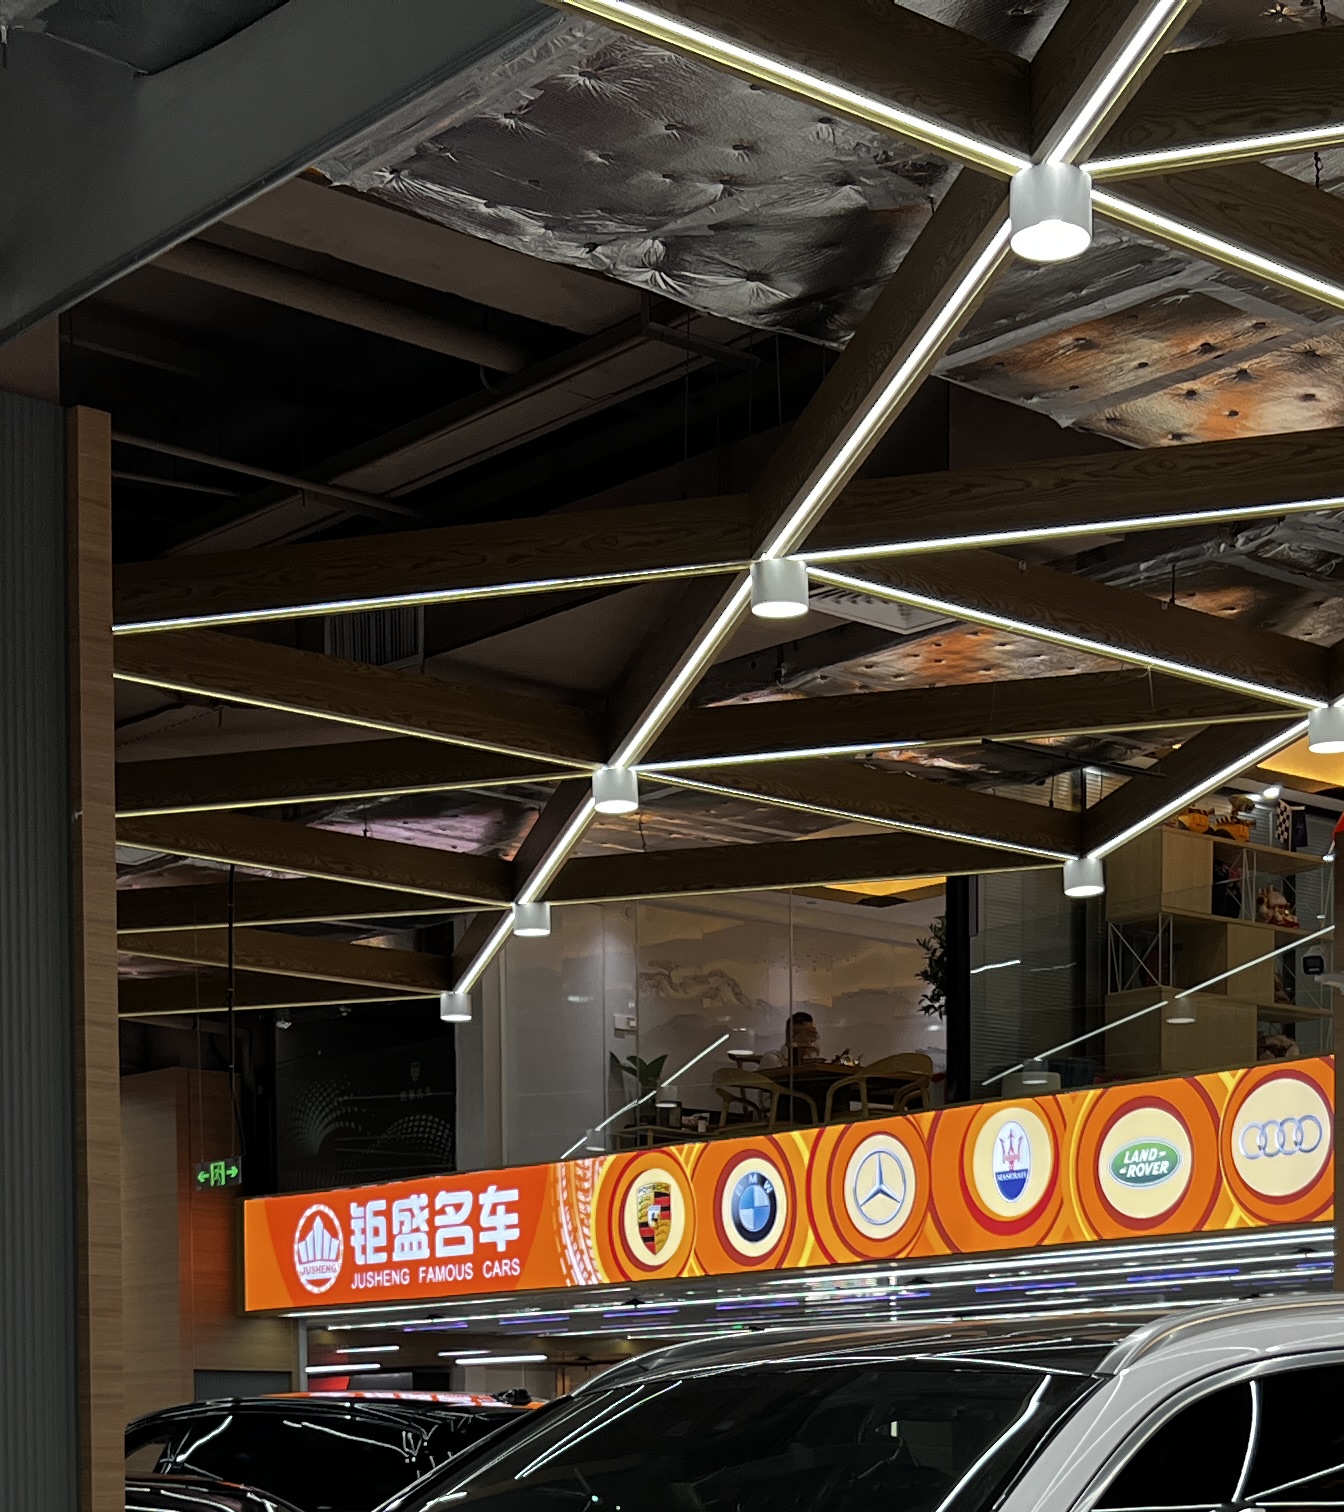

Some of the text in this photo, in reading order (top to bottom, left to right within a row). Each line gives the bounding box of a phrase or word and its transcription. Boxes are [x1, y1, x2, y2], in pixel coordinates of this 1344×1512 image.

[736, 1173, 773, 1196] BMW
[350, 1184, 520, 1265] 钜盛名车
[301, 1264, 337, 1275] JUSHENG
[351, 1257, 521, 1290] JUSHENG FAMOUS CARS
